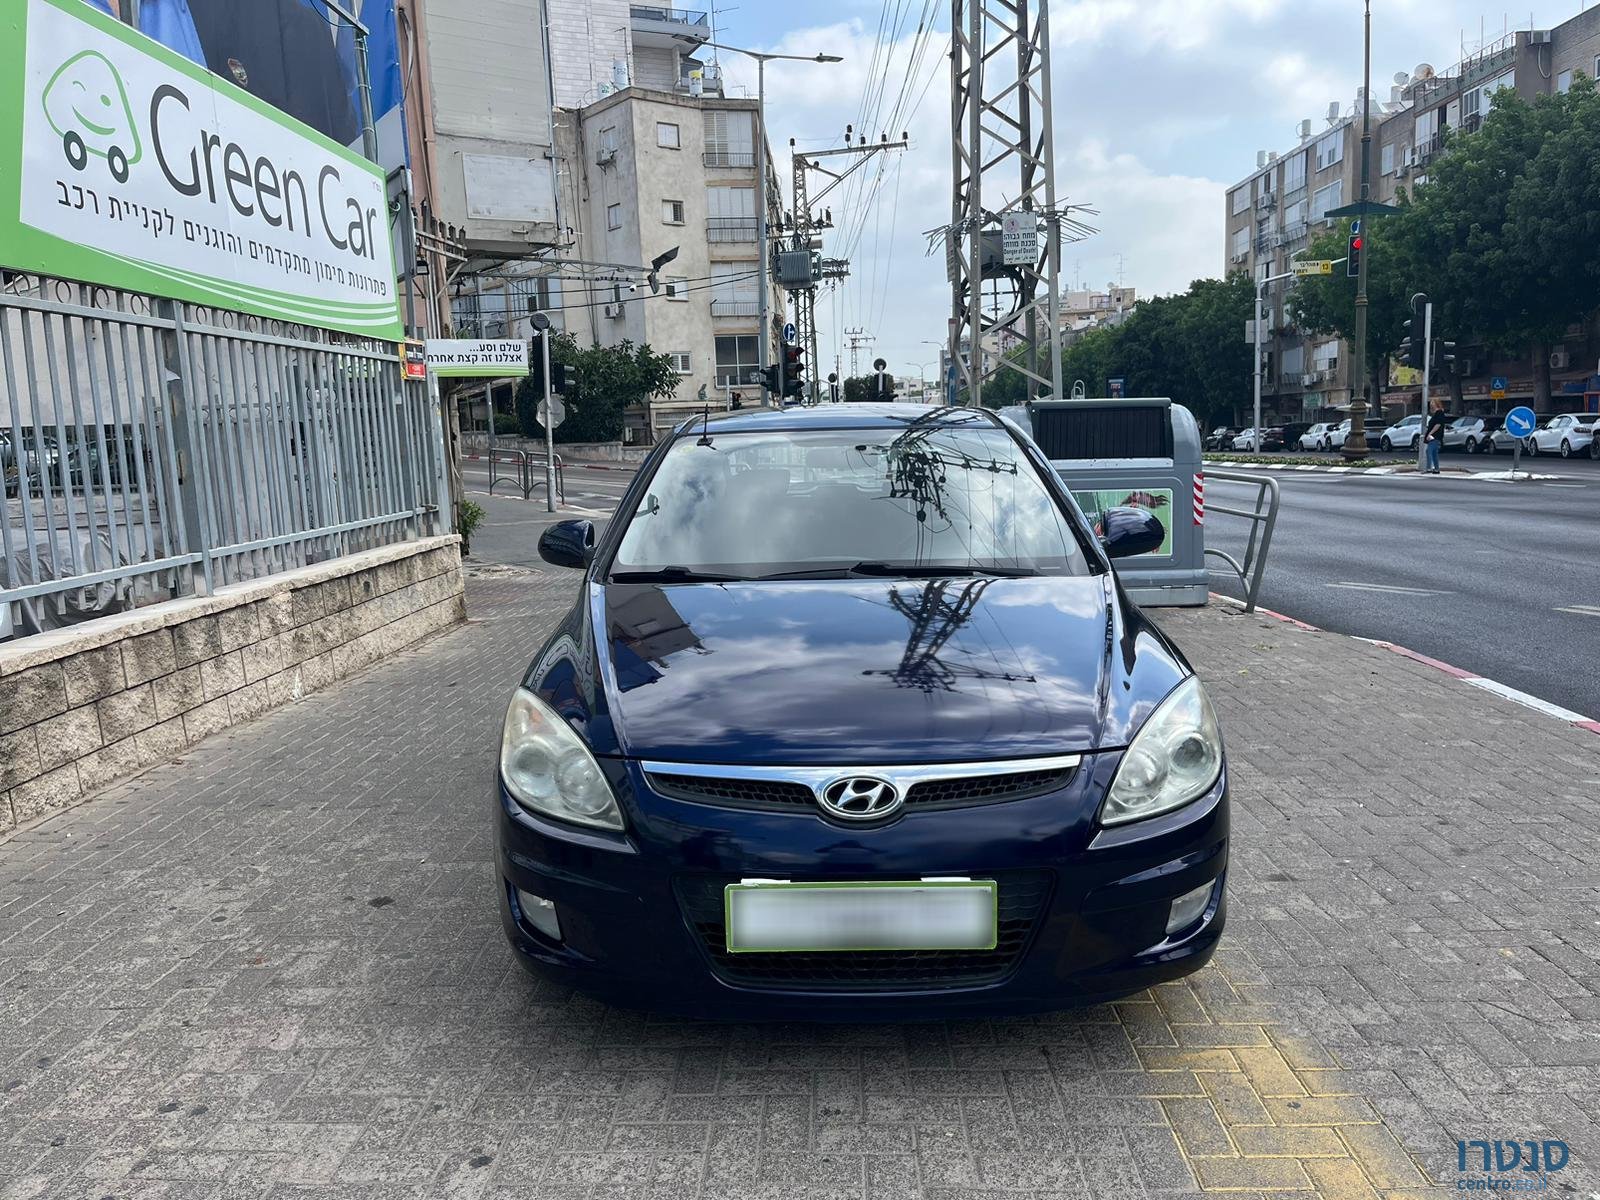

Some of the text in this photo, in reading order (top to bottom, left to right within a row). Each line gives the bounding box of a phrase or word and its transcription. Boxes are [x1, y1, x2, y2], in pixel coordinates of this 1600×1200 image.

[150, 84, 378, 261] Green Car
[56, 179, 387, 297] פתרונות מימון מתקדמים והוגנים לקניית רכב
[499, 342, 521, 352] שלם
[457, 354, 478, 364] קצת
[481, 354, 492, 362] זה
[495, 353, 522, 362] אצלנו
